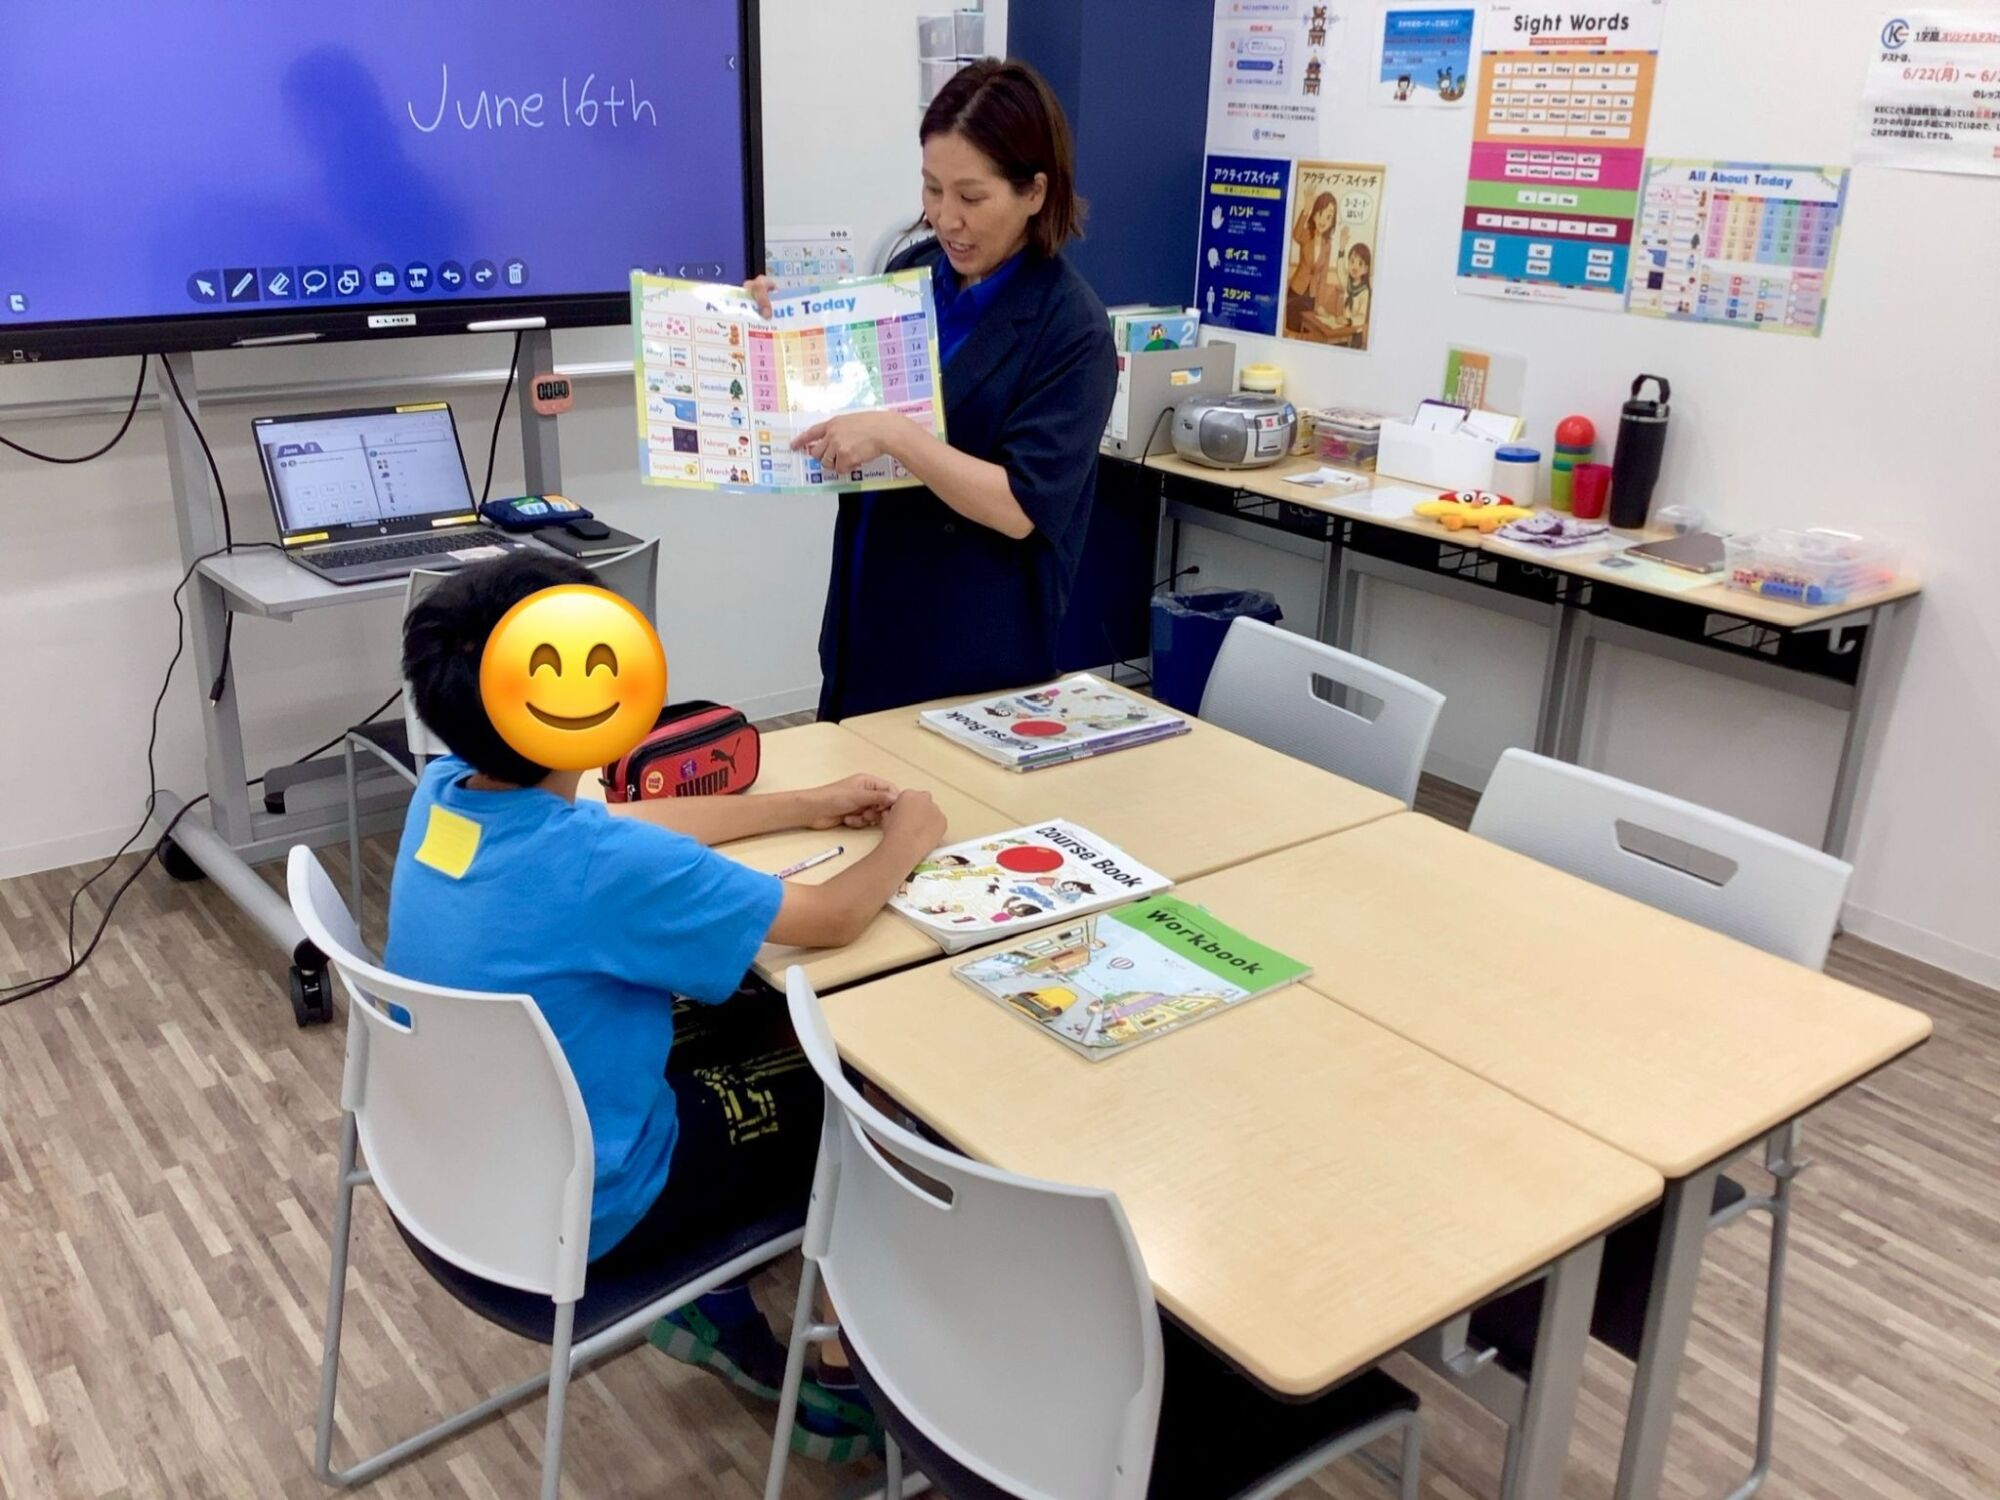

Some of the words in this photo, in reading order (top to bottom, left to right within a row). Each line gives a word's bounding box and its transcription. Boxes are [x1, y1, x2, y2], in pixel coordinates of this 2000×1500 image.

[1514, 15, 1562, 35] Sight
[1570, 13, 1629, 31] Words
[408, 63, 544, 132] June
[562, 73, 657, 127] 16th
[1214, 167, 1280, 185] アクティブスイッチ
[1688, 170, 1707, 182] All
[1710, 171, 1749, 185] About
[1754, 173, 1793, 190] Today
[1229, 205, 1254, 219] ハンド
[802, 294, 856, 314] Today
[1180, 321, 1195, 346] 2
[887, 347, 896, 355] 13
[912, 343, 921, 352] 14
[759, 374, 769, 382] 15
[888, 362, 898, 371] 20
[913, 359, 922, 367] 21
[889, 377, 899, 387] 27
[914, 373, 925, 383] 28
[760, 389, 770, 398] 22
[649, 404, 663, 414] July
[946, 710, 987, 733] Book
[675, 766, 729, 797] PUMA
[1035, 826, 1097, 861] Course
[1091, 858, 1144, 888] Book
[1146, 909, 1264, 976] Workbook
